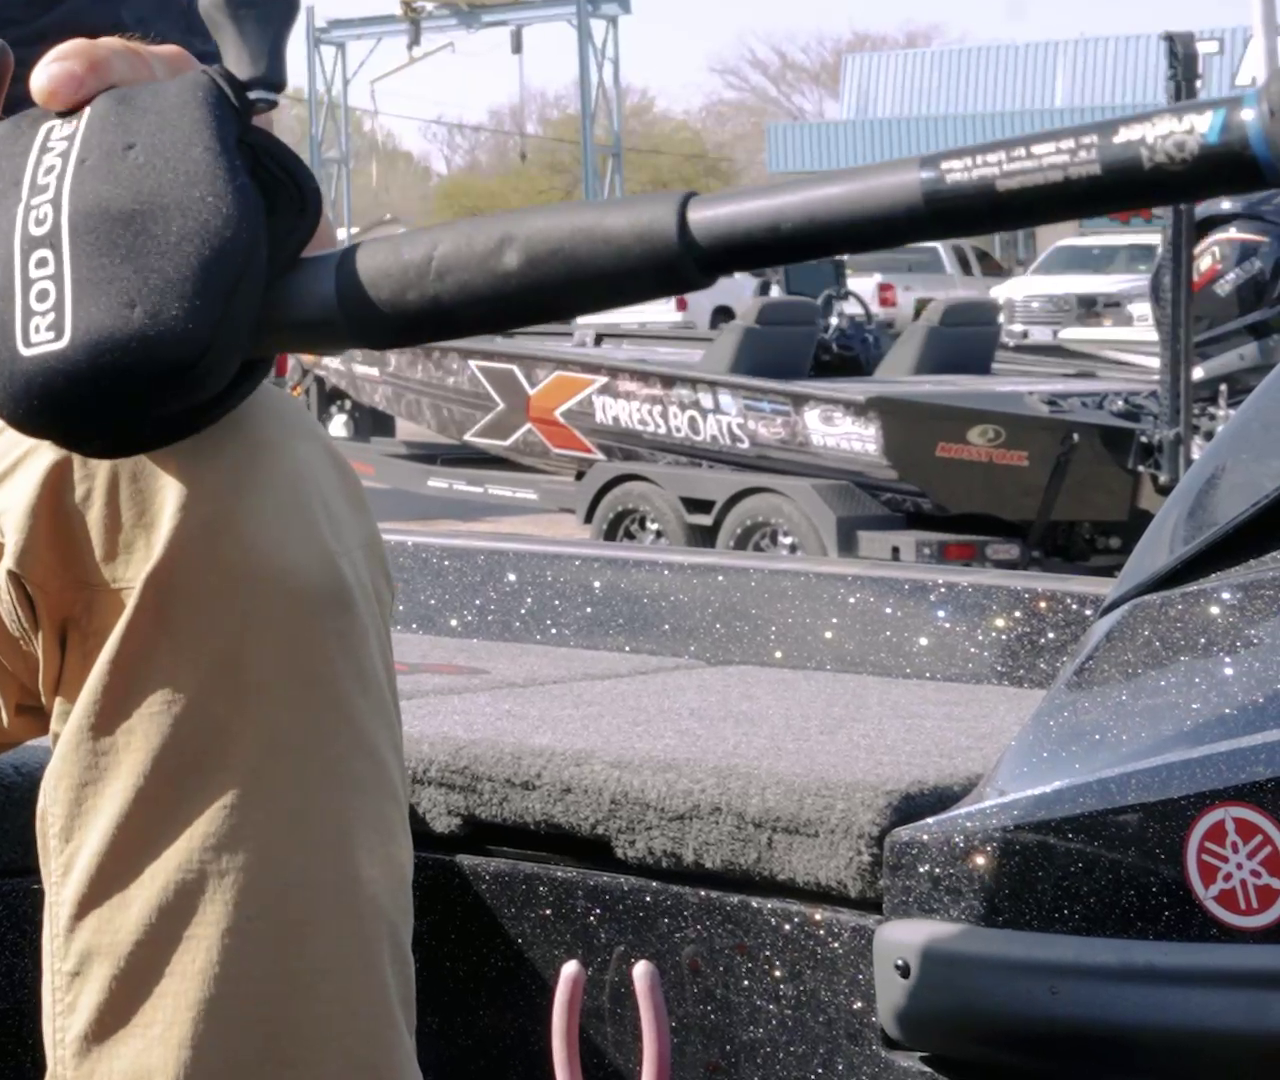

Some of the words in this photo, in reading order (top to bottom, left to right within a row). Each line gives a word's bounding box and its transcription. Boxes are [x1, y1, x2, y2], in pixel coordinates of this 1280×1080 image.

[27, 119, 78, 236] GLOVE
[28, 248, 57, 344] ROD
[591, 394, 668, 435] XPRESS
[667, 404, 751, 449] BOATS
